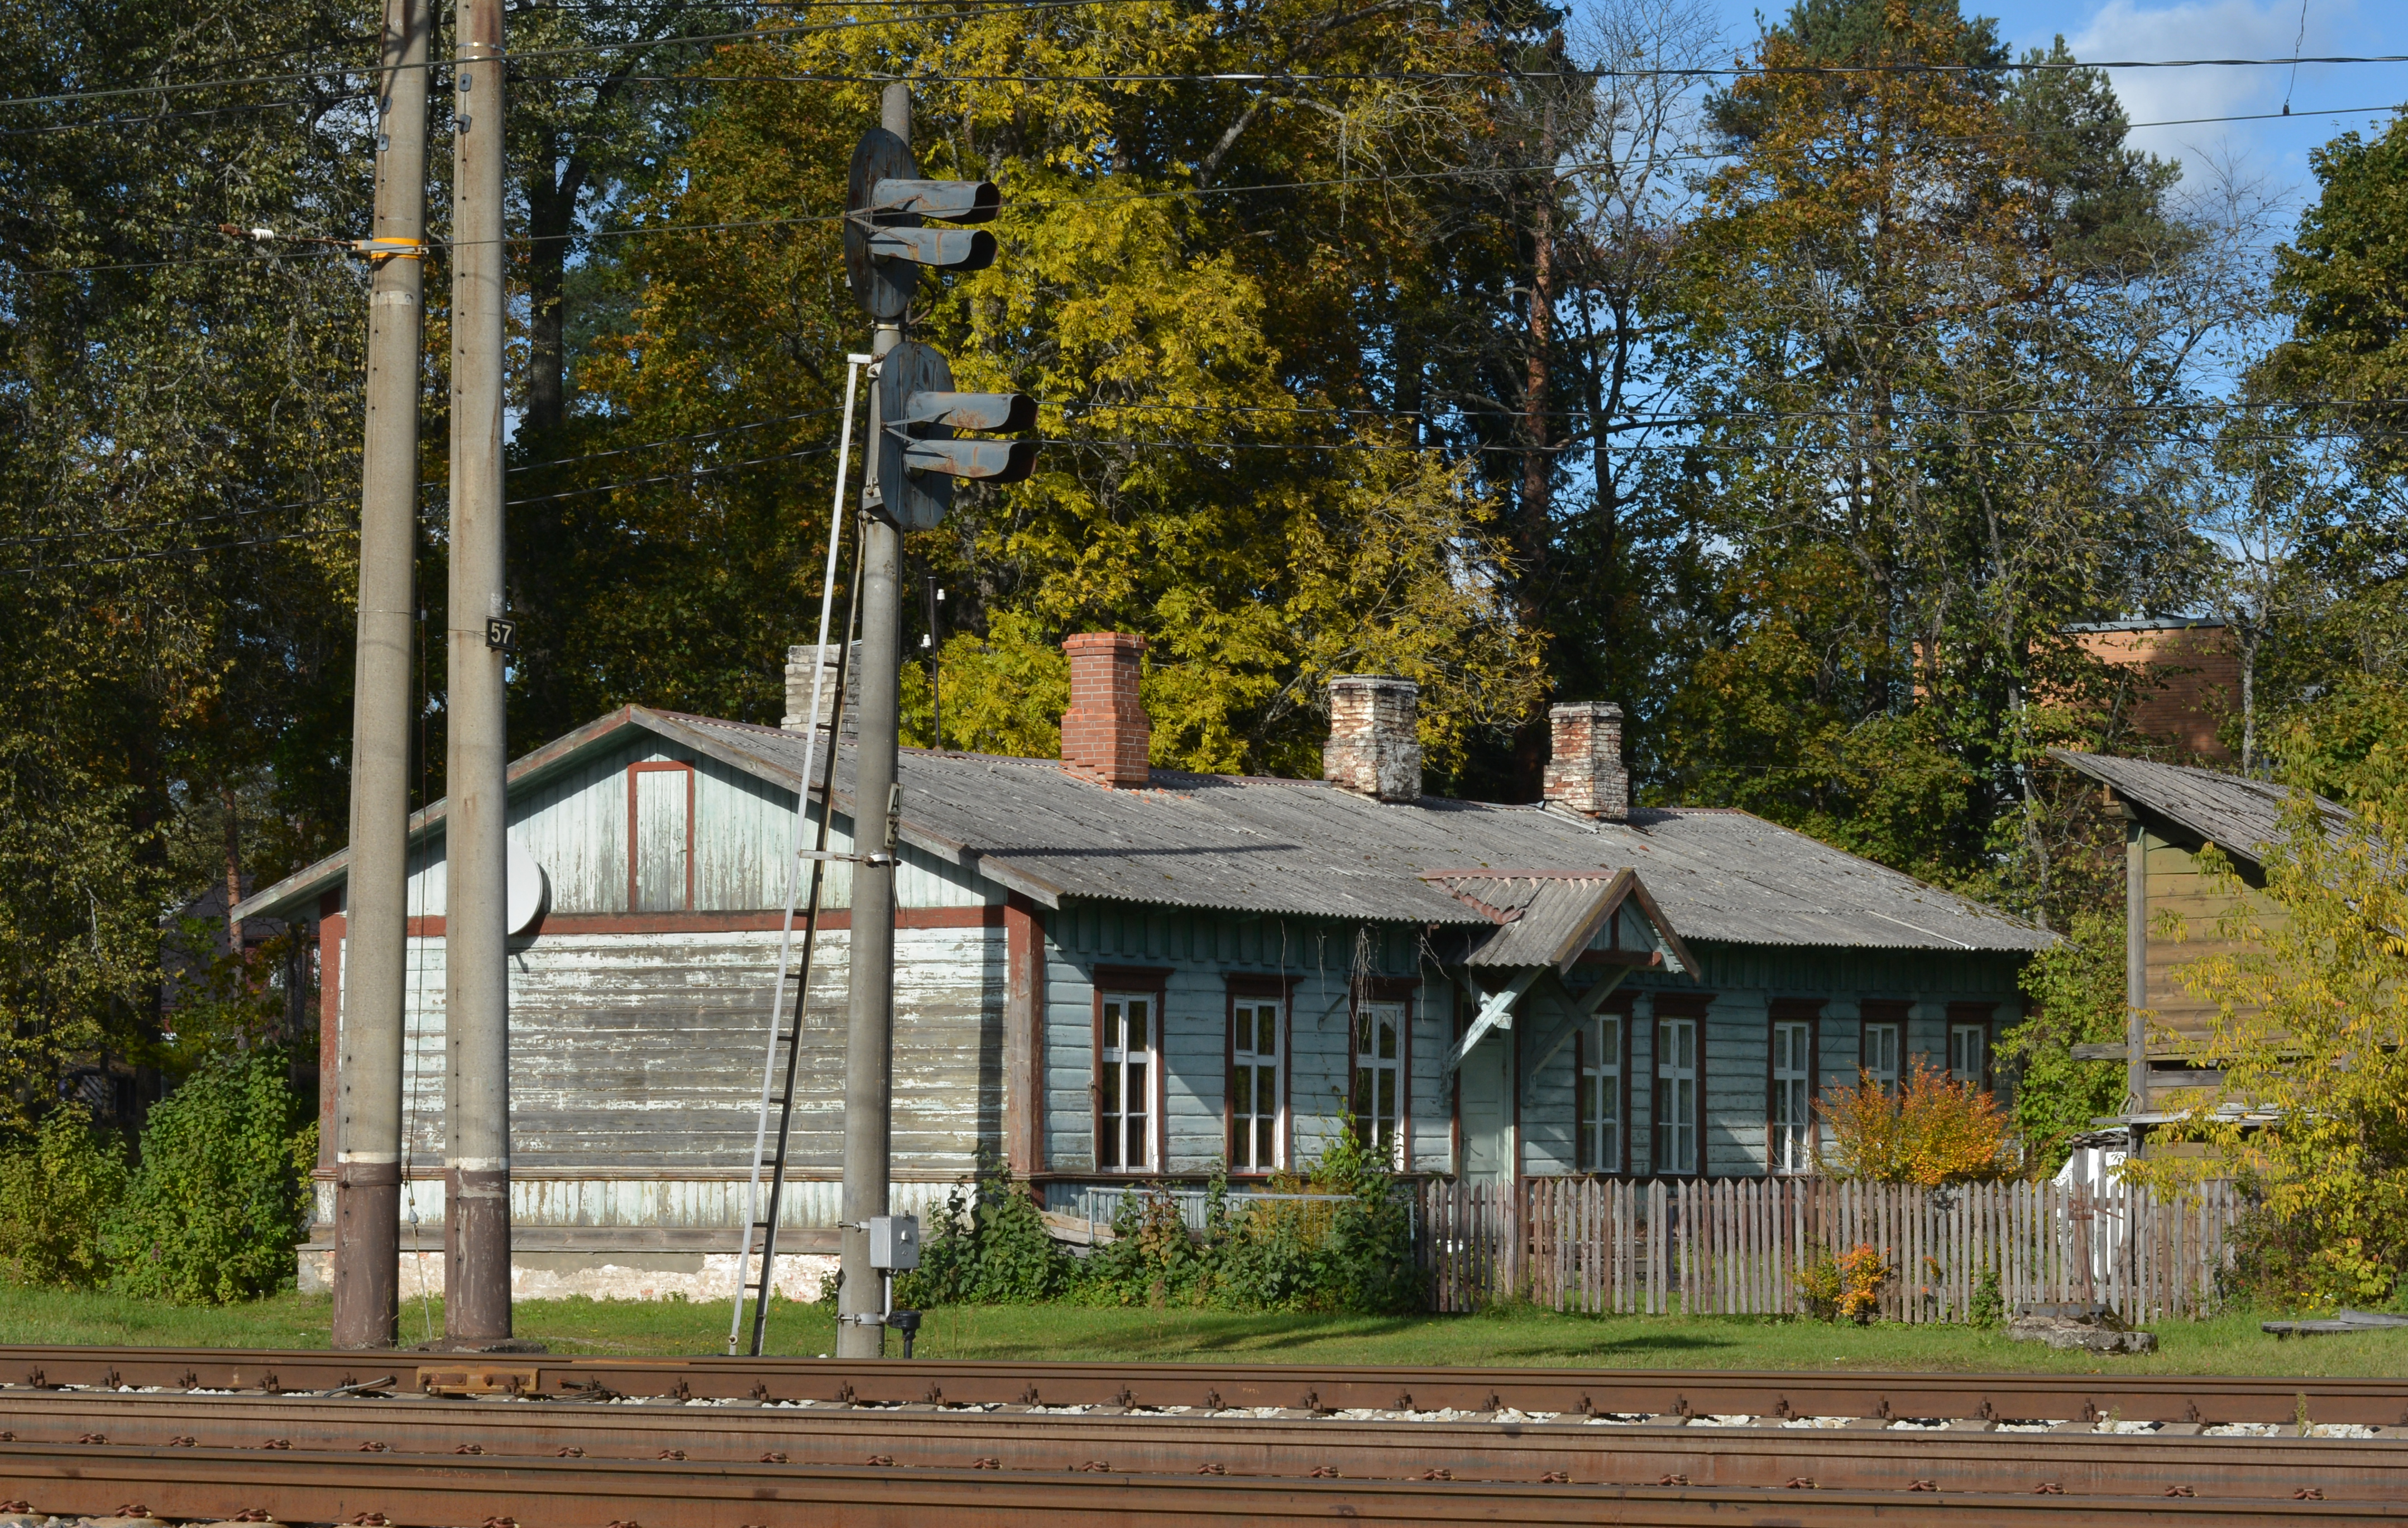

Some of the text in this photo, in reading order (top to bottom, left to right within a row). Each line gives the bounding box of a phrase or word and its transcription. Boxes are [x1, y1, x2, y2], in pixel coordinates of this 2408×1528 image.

[491, 622, 512, 644] 57
[891, 789, 899, 811] A
[887, 821, 898, 845] 3
